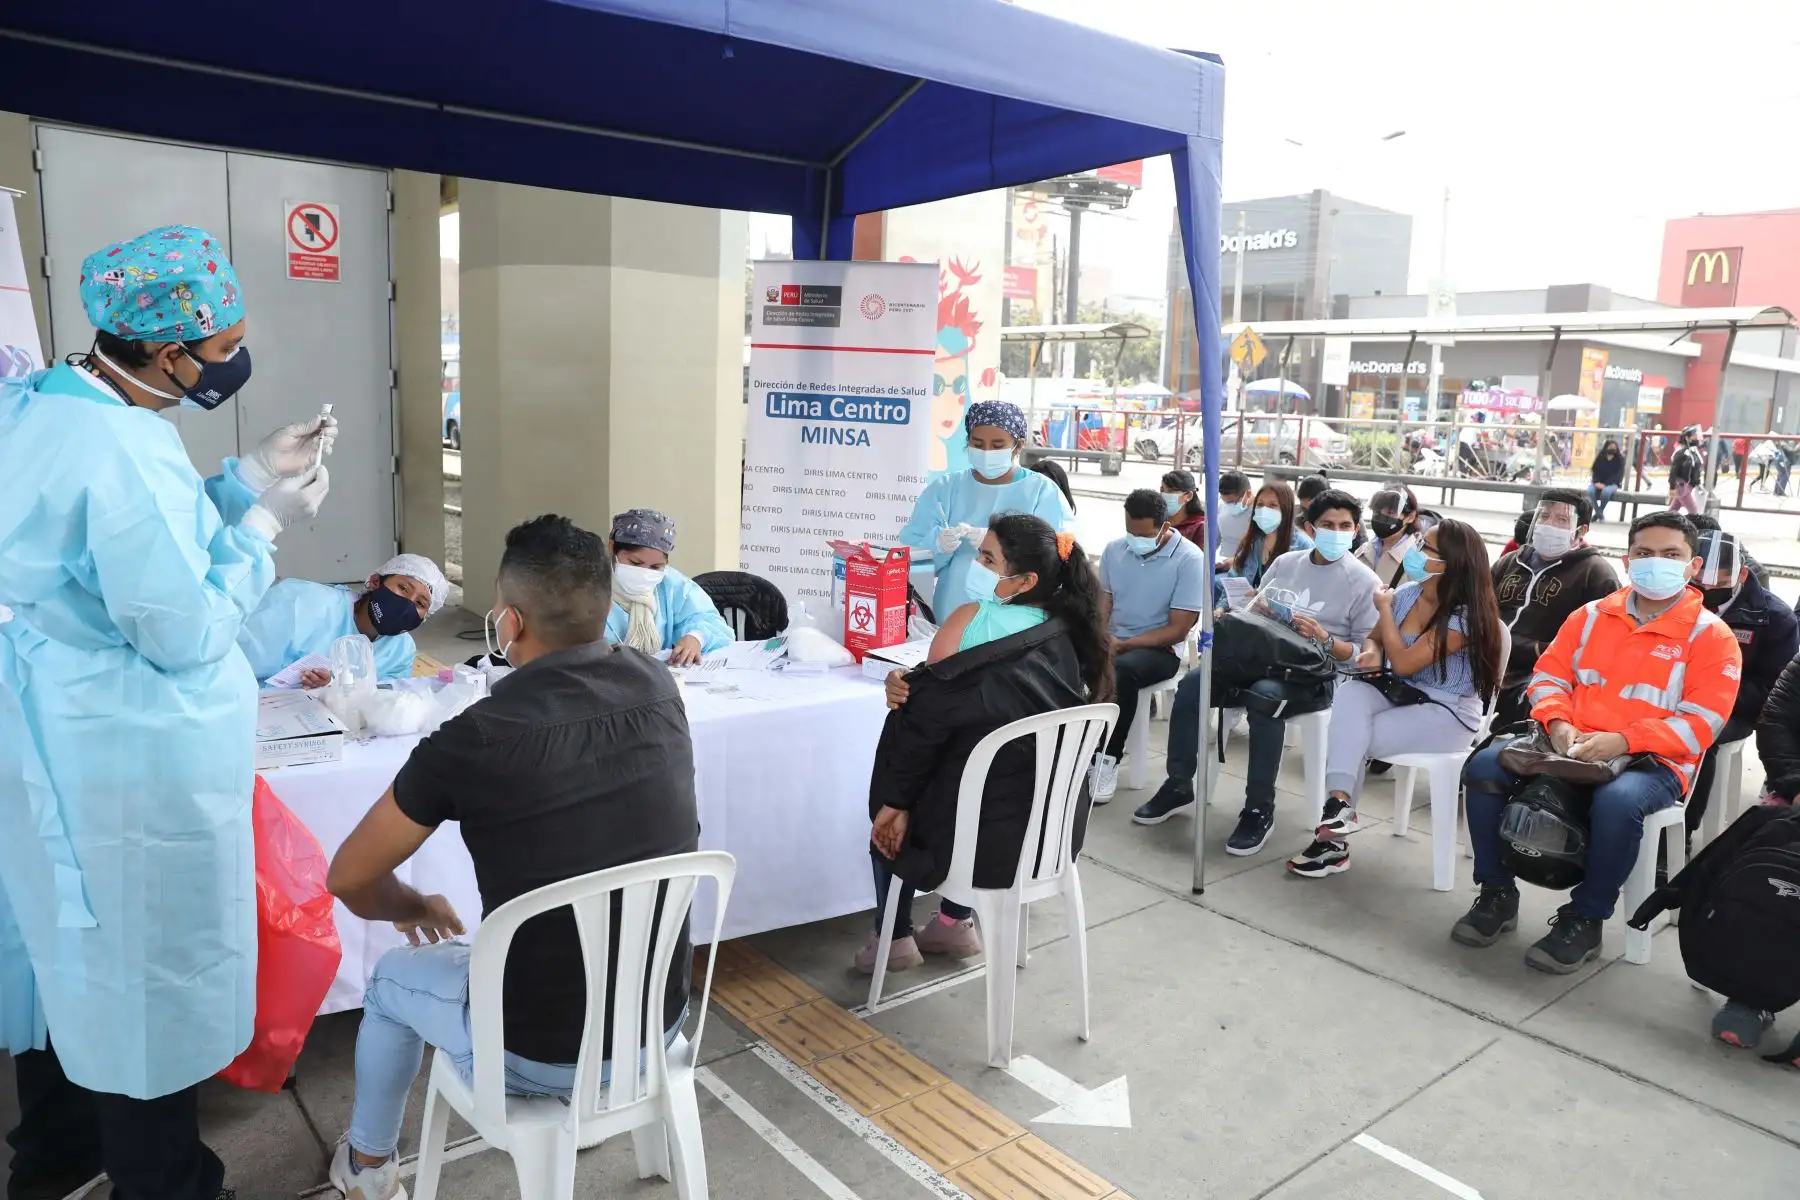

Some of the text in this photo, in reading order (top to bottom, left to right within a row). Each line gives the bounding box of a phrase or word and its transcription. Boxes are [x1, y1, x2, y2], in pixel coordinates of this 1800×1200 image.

[1221, 229, 1297, 252] Donald's
[1349, 360, 1427, 374] McDonad's
[754, 380, 926, 396] Dirección de Redes Integradas de Salud
[769, 394, 907, 421] Lima Centro
[801, 426, 871, 447] MINSA
[754, 466, 785, 474] CENTRO
[804, 468, 878, 481] DIRIS LIMA CENTRO
[897, 474, 918, 483] DIRIS
[772, 485, 846, 498] DIRIS LIMA CENTRO
[865, 492, 886, 500] DIRIS
[888, 493, 907, 502] LIMA
[752, 505, 783, 514] CENTRO
[801, 508, 876, 521] DIRIS LIMA CENTRO
[770, 525, 844, 537] DIRIS LIMA CENTRO
[863, 532, 899, 542] DIRIS LIM
[750, 544, 781, 554] CENTRO
[799, 548, 820, 557] DIRIS
[768, 564, 789, 573] DIRIS
[789, 566, 809, 575] LIMA
[810, 567, 832, 576] CENT
[797, 588, 818, 597] DIRIS
[262, 739, 326, 752] SAFETY SYRINGE
